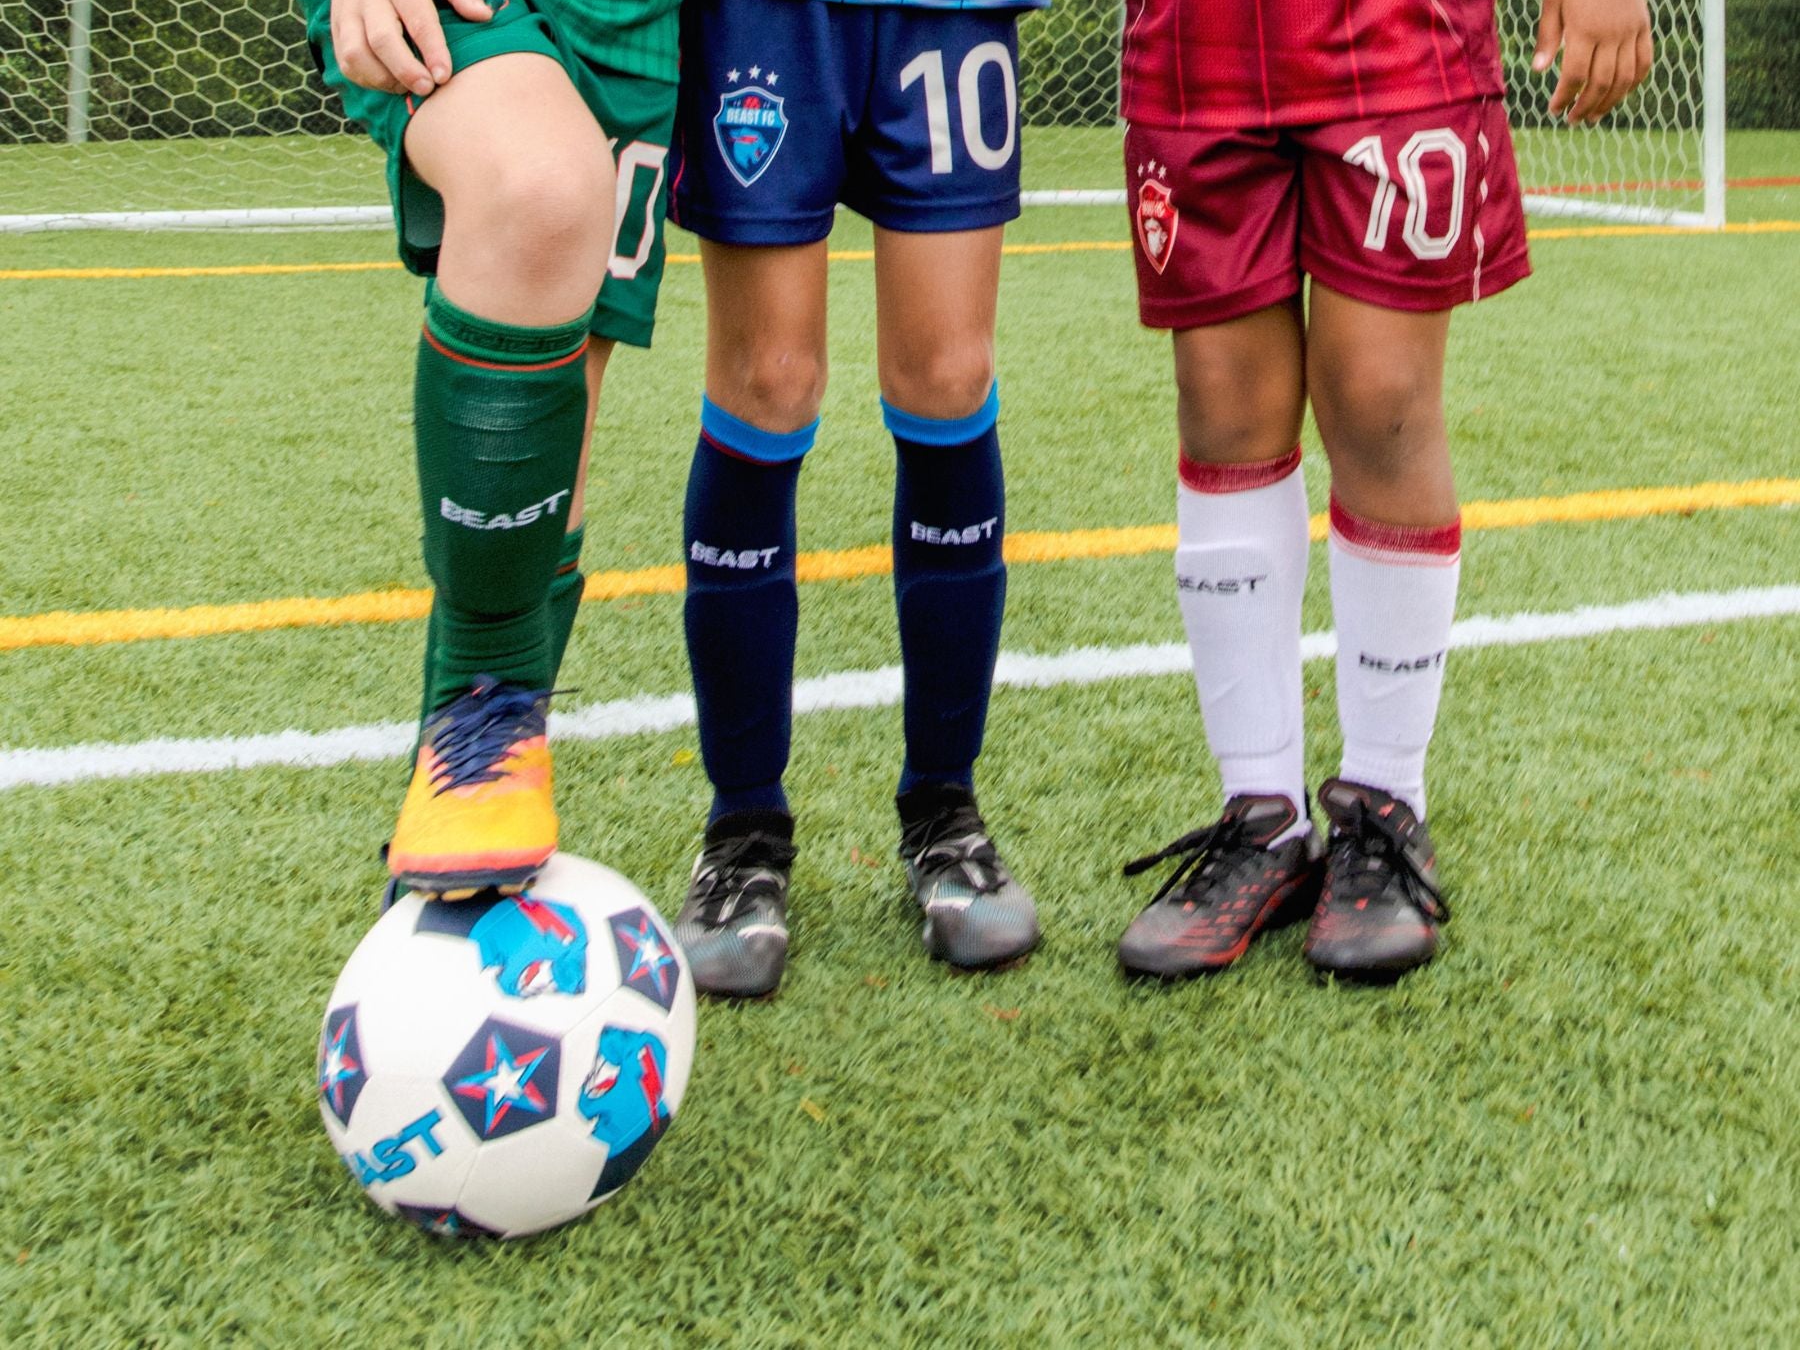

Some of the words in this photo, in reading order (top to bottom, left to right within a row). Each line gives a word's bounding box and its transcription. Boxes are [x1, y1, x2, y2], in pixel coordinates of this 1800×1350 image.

[726, 107, 761, 126] BEAST
[899, 41, 1018, 175] 10
[606, 138, 670, 281] 0
[1342, 127, 1468, 261] 10
[440, 489, 570, 531] BEAST
[910, 516, 999, 546] BEAST
[690, 539, 780, 570] BEAST
[346, 1108, 445, 1186] AST
